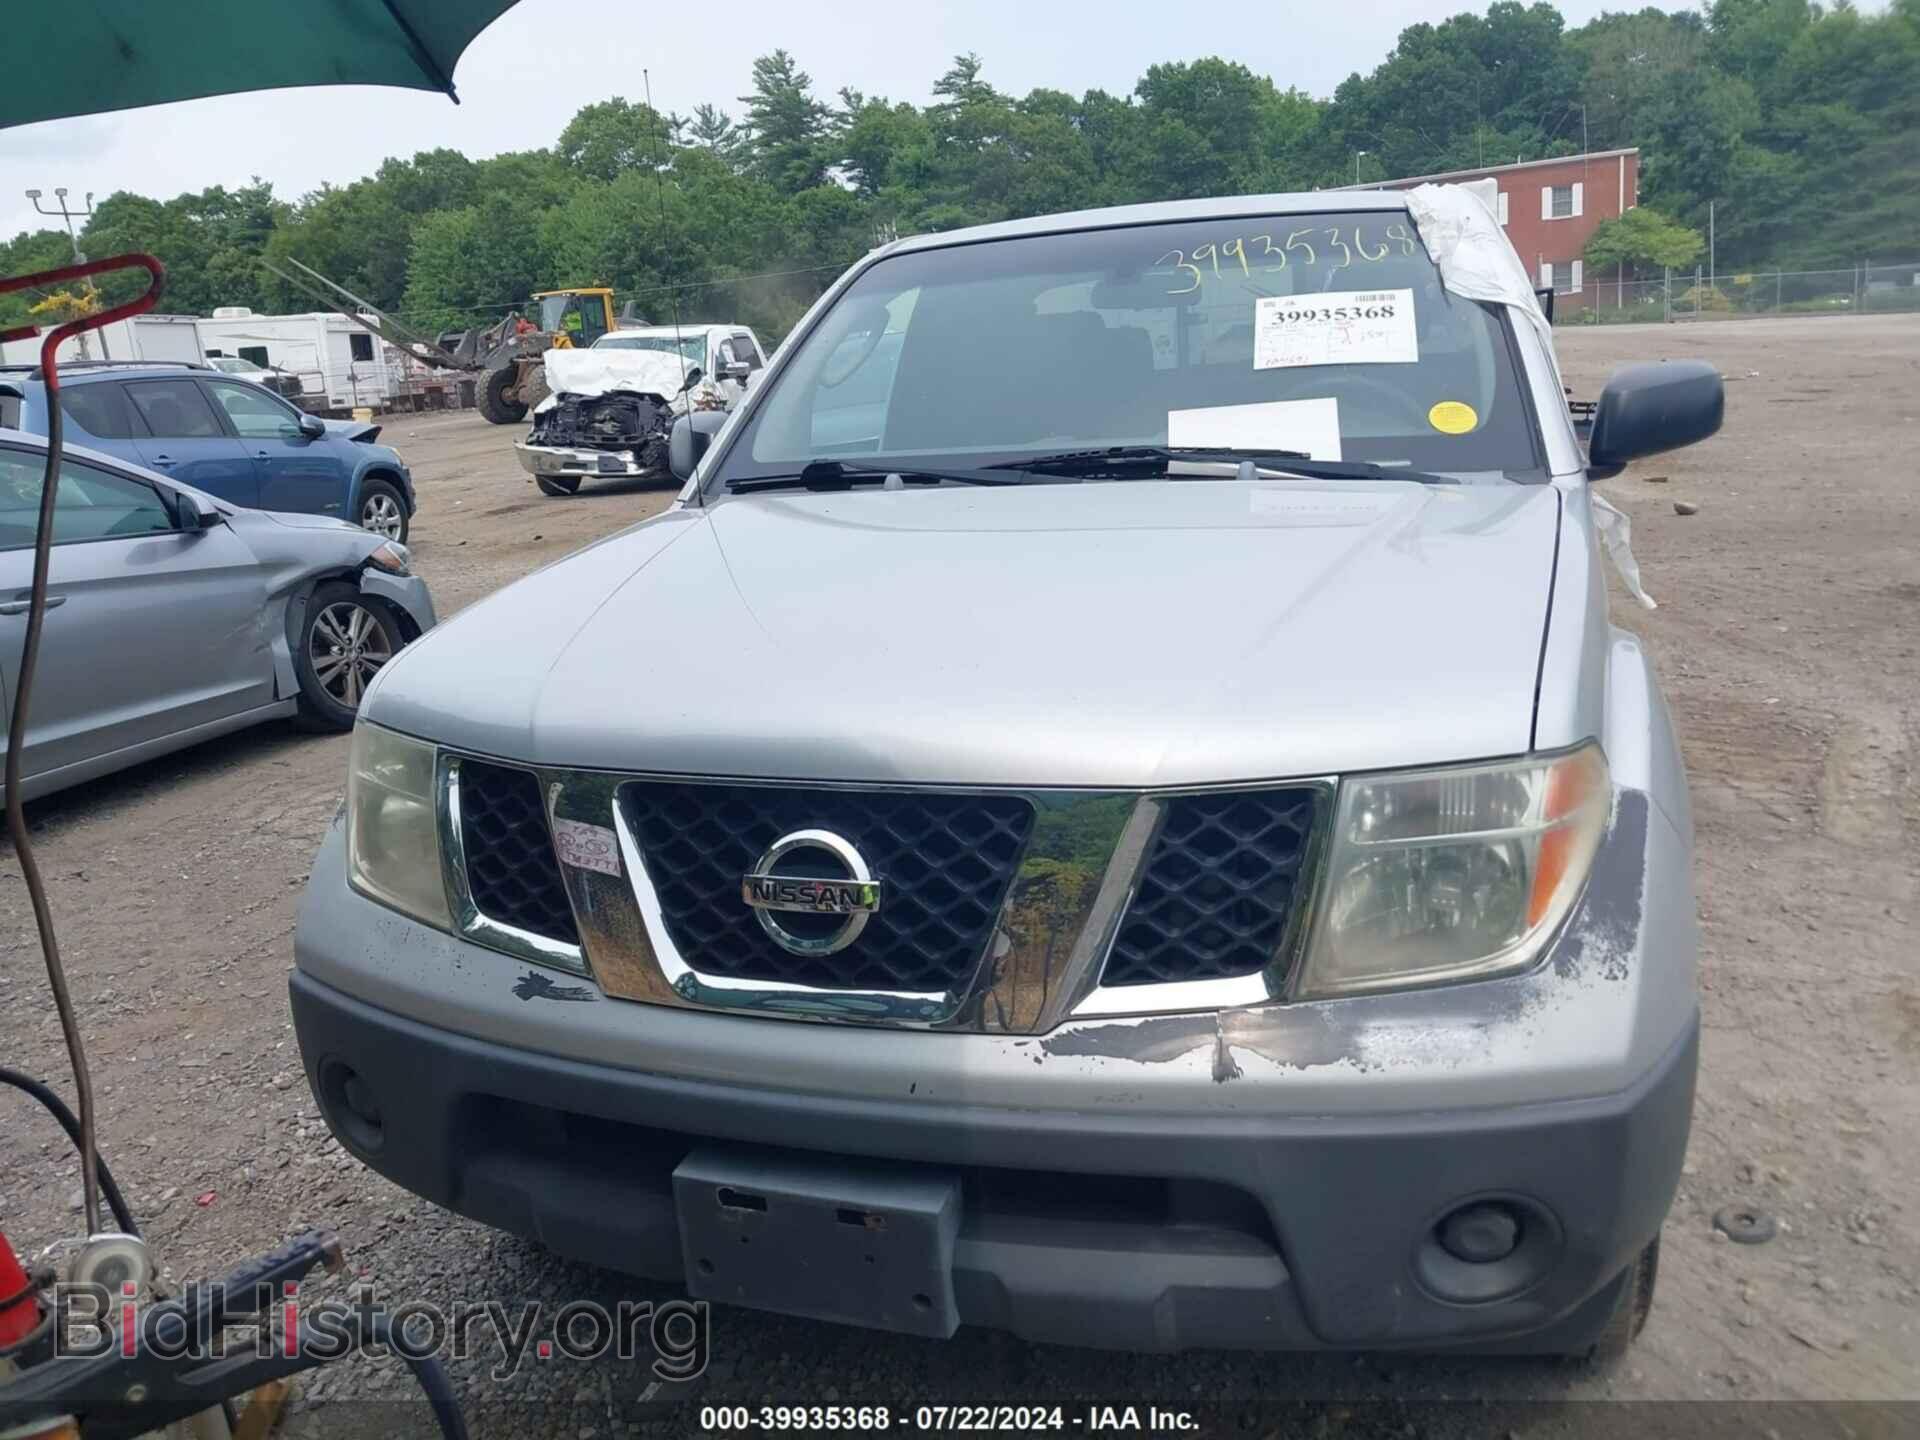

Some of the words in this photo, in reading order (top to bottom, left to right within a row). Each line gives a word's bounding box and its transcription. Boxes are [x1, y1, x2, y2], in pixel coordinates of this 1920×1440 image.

[1155, 224, 1416, 294] 39935368
[1271, 304, 1396, 326] 39935368
[751, 881, 862, 907] NISSAN
